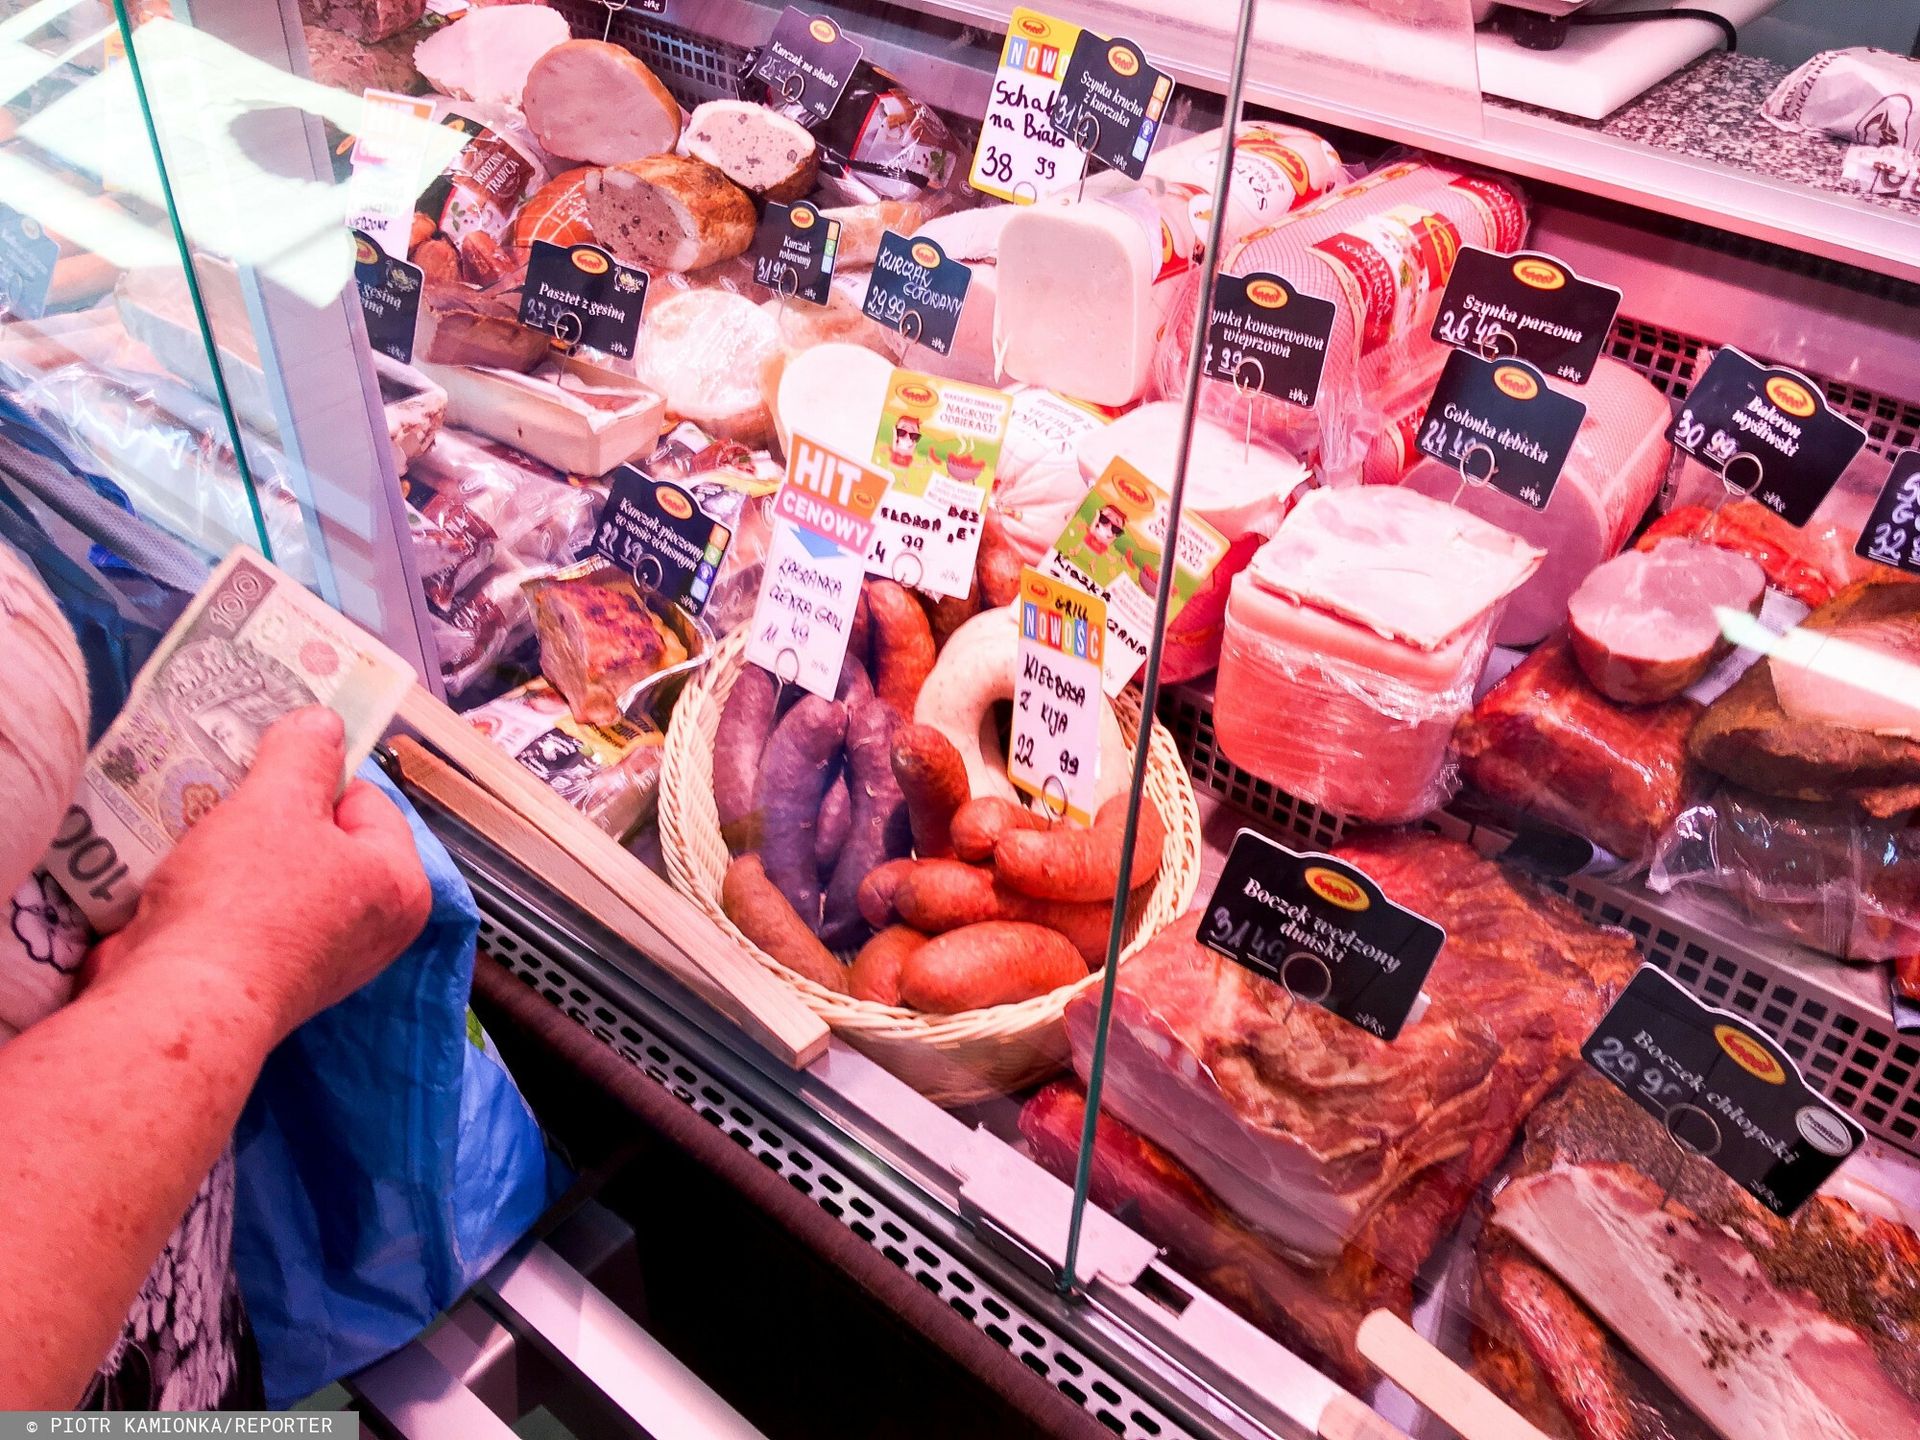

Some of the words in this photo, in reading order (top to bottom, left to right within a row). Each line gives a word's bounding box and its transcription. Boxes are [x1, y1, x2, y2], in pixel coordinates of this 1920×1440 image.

[771, 41, 804, 69] Kurczak
[801, 62, 813, 74] na
[812, 67, 839, 88] słodko
[1010, 40, 1071, 77] NOWO
[1080, 70, 1112, 99] Szynka
[1112, 88, 1144, 118] krucha
[1083, 92, 1091, 104] z
[1089, 92, 1131, 128] kurczaka
[989, 112, 1015, 132] na
[981, 146, 1013, 183] 38
[1035, 156, 1056, 180] 99
[779, 249, 812, 270] rolowany
[783, 234, 812, 254] Kurczak
[757, 256, 773, 281] 31
[538, 281, 581, 307] Pasztet
[581, 297, 590, 310] z
[588, 300, 626, 324] gęsiną
[867, 285, 888, 315] 29
[887, 295, 906, 318] 99
[1463, 294, 1518, 323] Szynka
[1517, 314, 1583, 344] parzona
[1211, 308, 1242, 328] ynka
[1244, 314, 1325, 351] konserwowa
[1223, 328, 1291, 359] wieprzowa
[1439, 310, 1474, 342] 26
[946, 402, 995, 424] NAGRODY
[1444, 402, 1497, 440] Golonka
[1497, 428, 1550, 464] dębicka
[1675, 409, 1705, 448] 30
[1731, 409, 1800, 458] myśliwski
[1747, 395, 1802, 438] Baleron
[1421, 418, 1448, 452] 24
[794, 442, 863, 507] HIT
[620, 497, 661, 533] Kurczak
[659, 525, 705, 562] pieczony
[625, 520, 652, 543] sosie
[782, 490, 869, 548] CENOWY
[209, 573, 263, 631] 100
[1055, 597, 1088, 621] GRILL
[1025, 606, 1099, 661] NOWOŚĆ
[1015, 733, 1034, 769] 22
[1060, 748, 1080, 776] 99
[1242, 877, 1311, 925] Boczek
[1313, 916, 1402, 975] wędzony
[1280, 919, 1348, 963] duński
[1633, 1029, 1705, 1093] Boczek
[1706, 1091, 1800, 1166] chłopski
